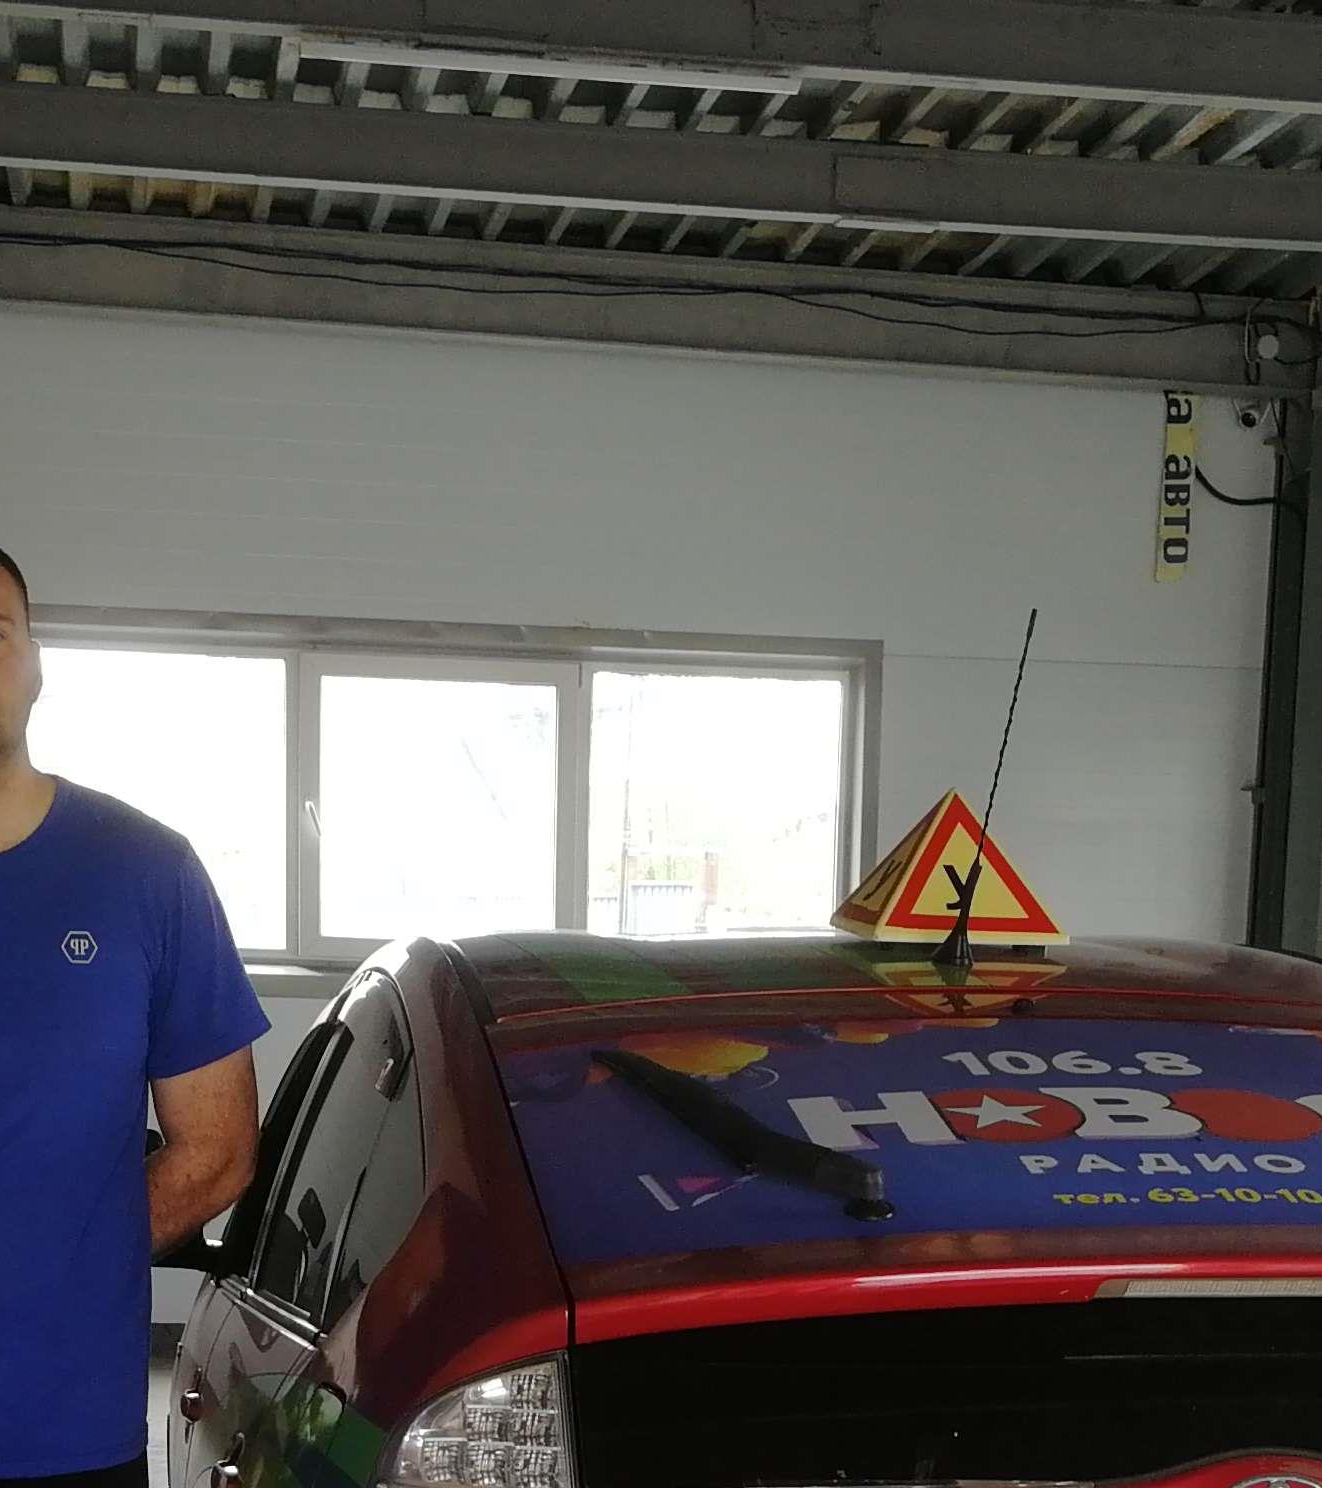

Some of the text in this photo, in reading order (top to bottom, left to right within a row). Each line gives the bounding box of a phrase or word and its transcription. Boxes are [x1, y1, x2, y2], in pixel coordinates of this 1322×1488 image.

[1163, 390, 1192, 424] а
[943, 862, 982, 911] У
[942, 1050, 1203, 1077] 106.8
[1019, 1153, 1307, 1175] РАДИО
